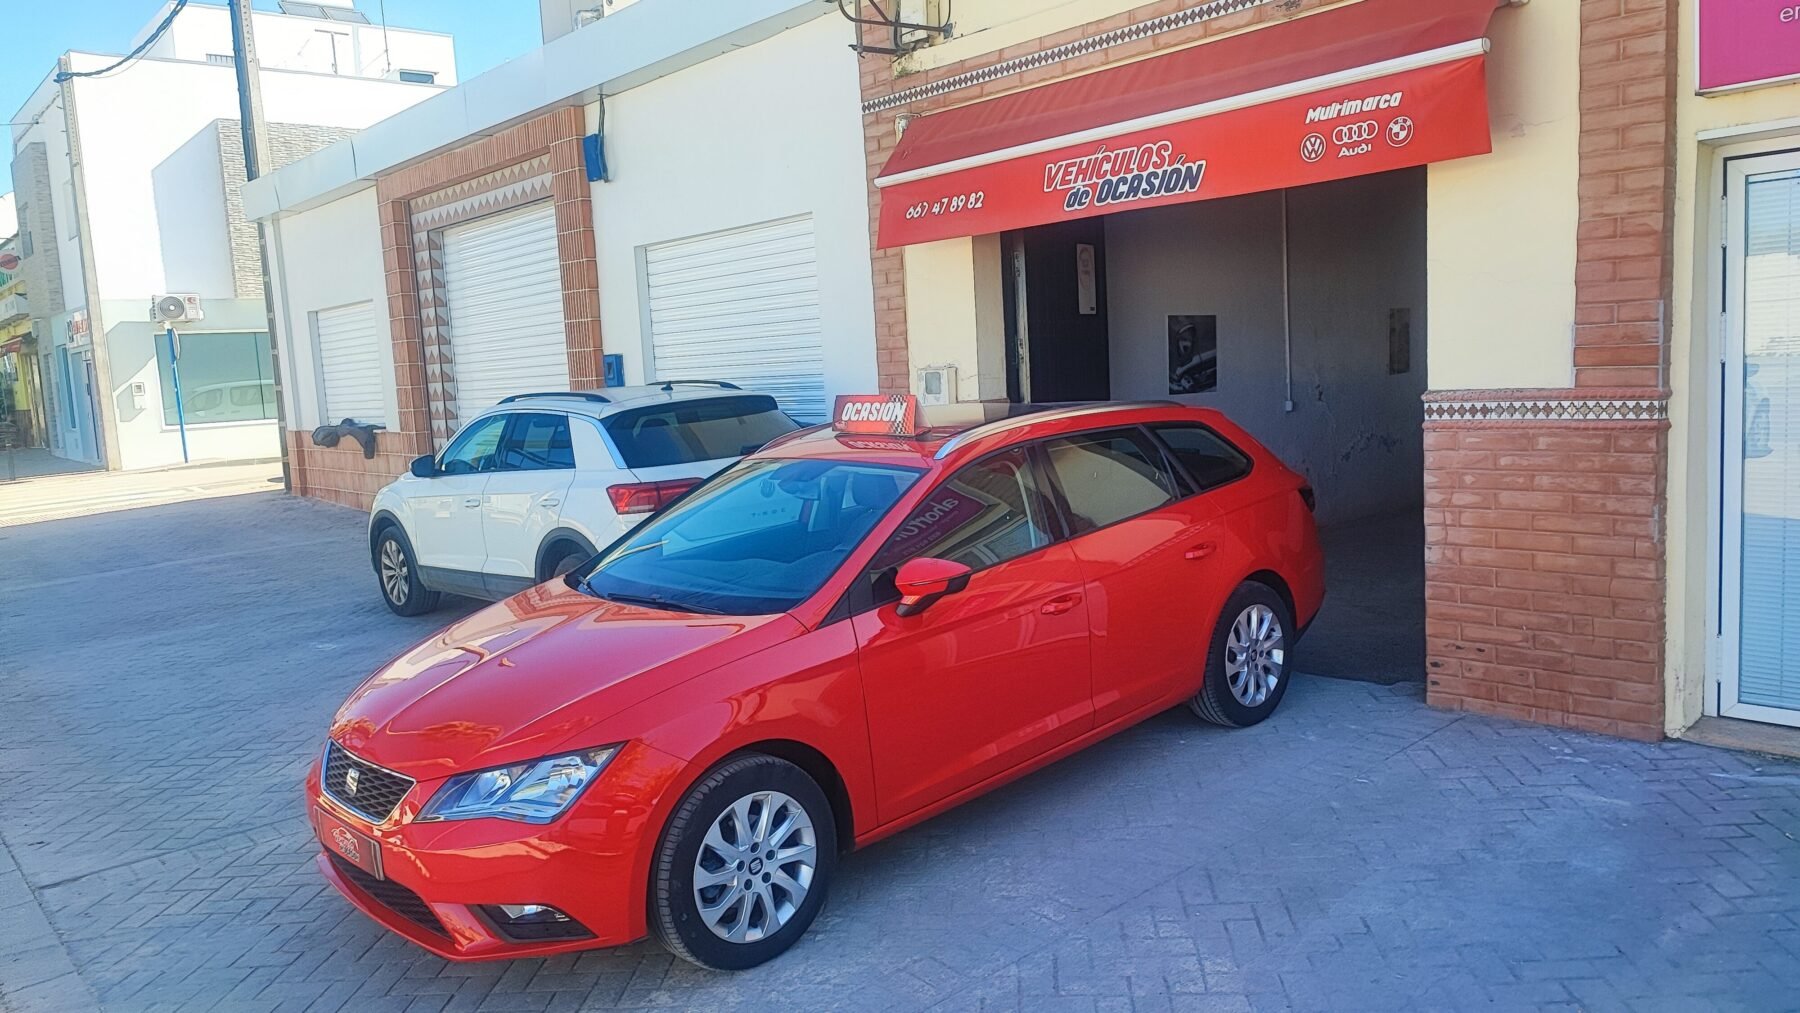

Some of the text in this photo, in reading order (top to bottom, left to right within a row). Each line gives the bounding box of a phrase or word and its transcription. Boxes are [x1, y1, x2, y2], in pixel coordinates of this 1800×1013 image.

[1305, 91, 1403, 124] Multimarca
[1044, 140, 1172, 191] VEHÍCULOS
[1338, 143, 1372, 158] Audi
[1064, 154, 1206, 211] de OCASIÓN
[906, 191, 984, 219] 667 47 89 82
